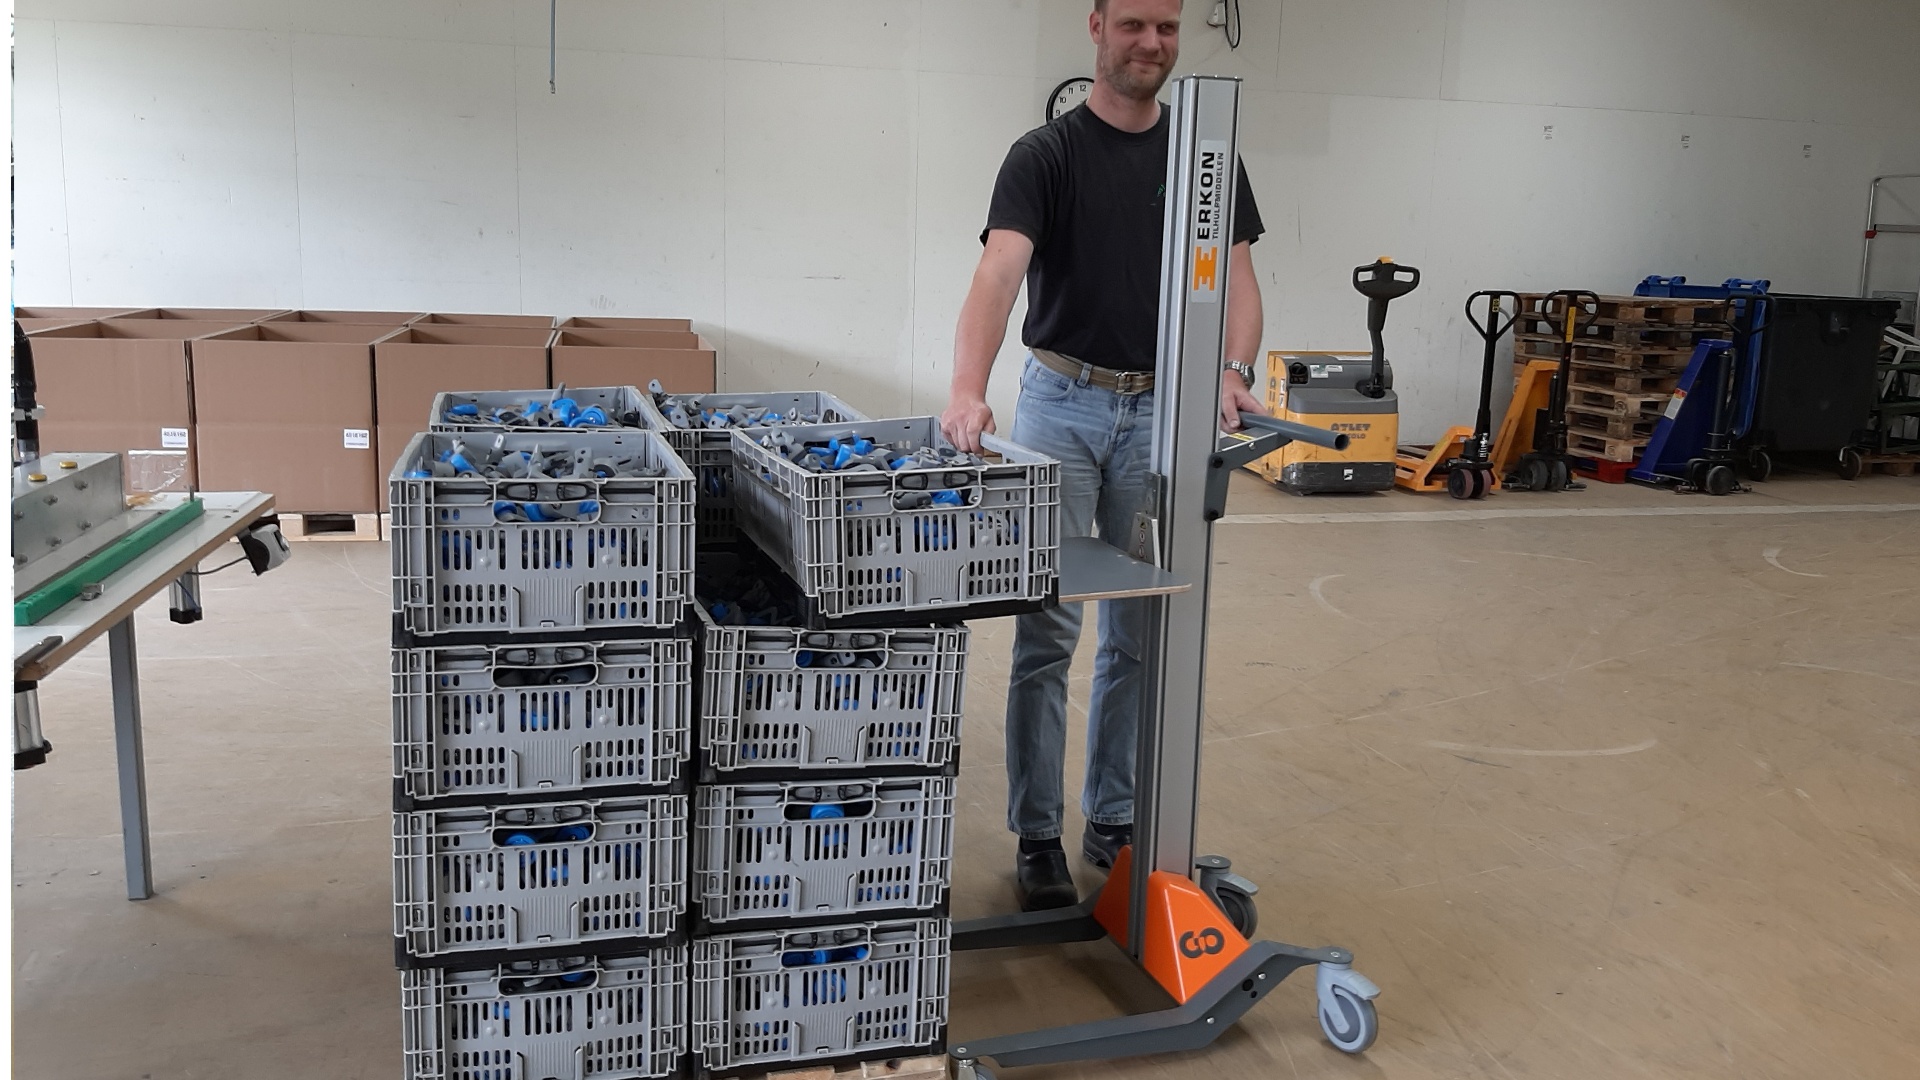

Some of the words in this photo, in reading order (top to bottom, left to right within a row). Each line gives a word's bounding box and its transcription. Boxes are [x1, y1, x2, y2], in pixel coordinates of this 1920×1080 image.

[1079, 84, 1087, 92] 12
[1059, 96, 1067, 104] 10
[1196, 151, 1215, 240] ERKON
[1212, 152, 1224, 240] TILHULPMIDDELEN
[1331, 423, 1371, 431] ATLET
